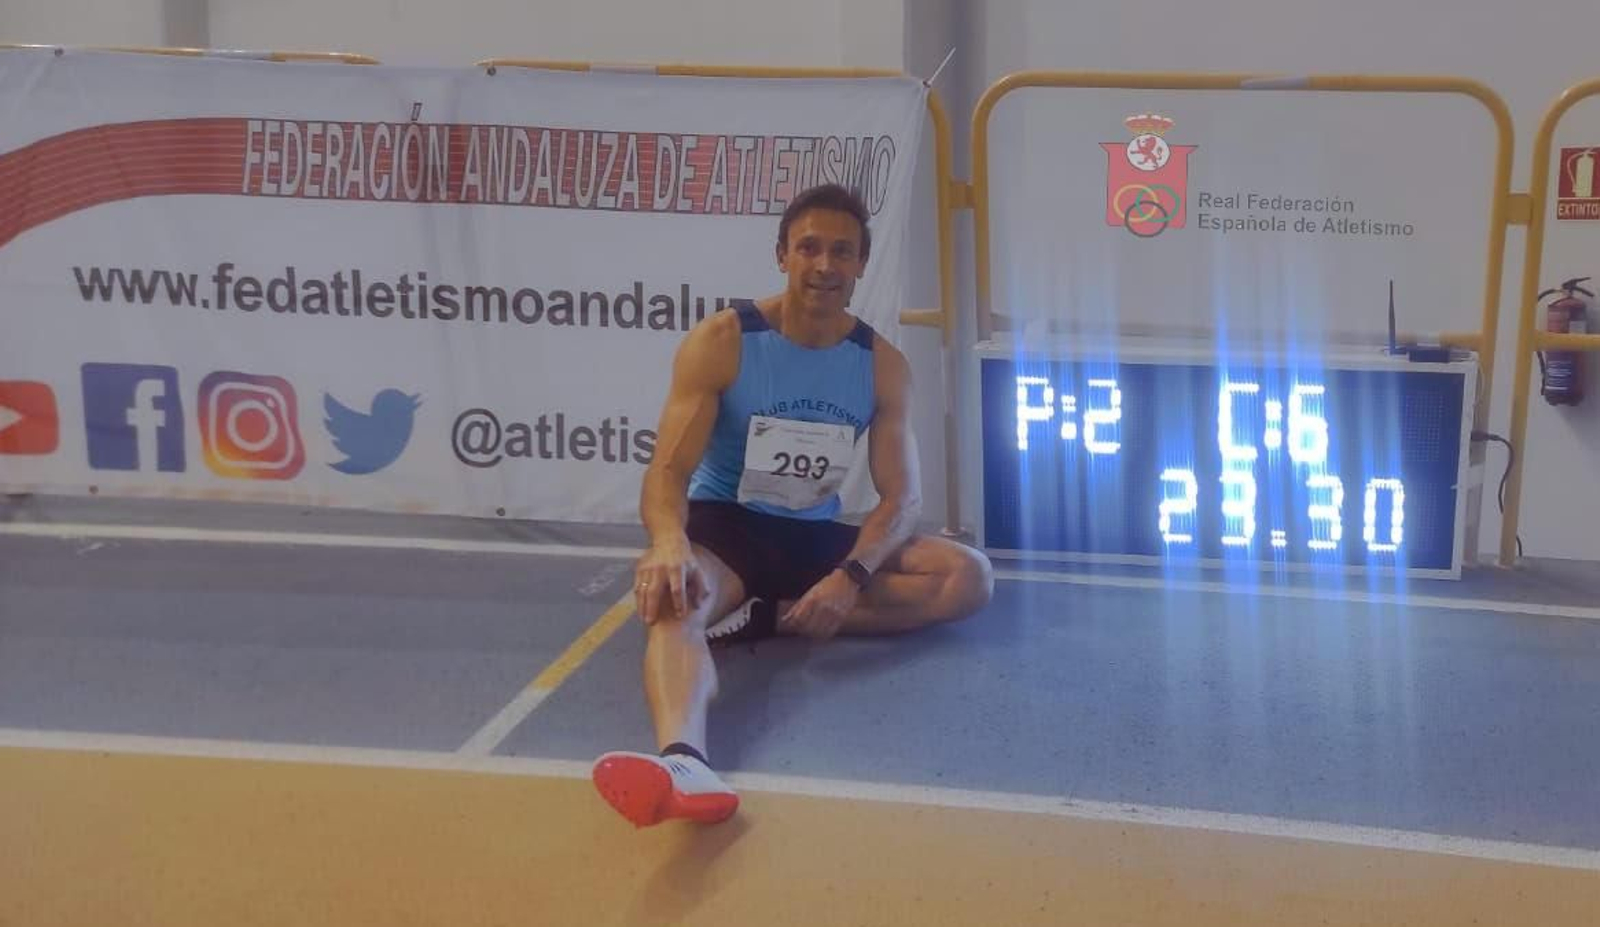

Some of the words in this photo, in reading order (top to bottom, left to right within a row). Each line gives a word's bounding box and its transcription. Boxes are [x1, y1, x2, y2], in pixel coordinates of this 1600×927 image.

[242, 102, 451, 202] FEDERACIÓN
[460, 125, 642, 211] ANDALUZA
[653, 132, 699, 213] DE
[704, 133, 896, 217] ATLETISMO
[1198, 193, 1240, 210] Real
[1247, 194, 1355, 213] Federación
[1198, 213, 1287, 234] Española
[1293, 216, 1317, 234] de
[1322, 217, 1415, 237] Atletismo
[1558, 203, 1600, 217] EXTINTO
[73, 262, 755, 332] www.fedatletismoandalu
[451, 407, 658, 468] @atletis
[770, 452, 830, 480] 293
[1159, 468, 1405, 551] 23.30
